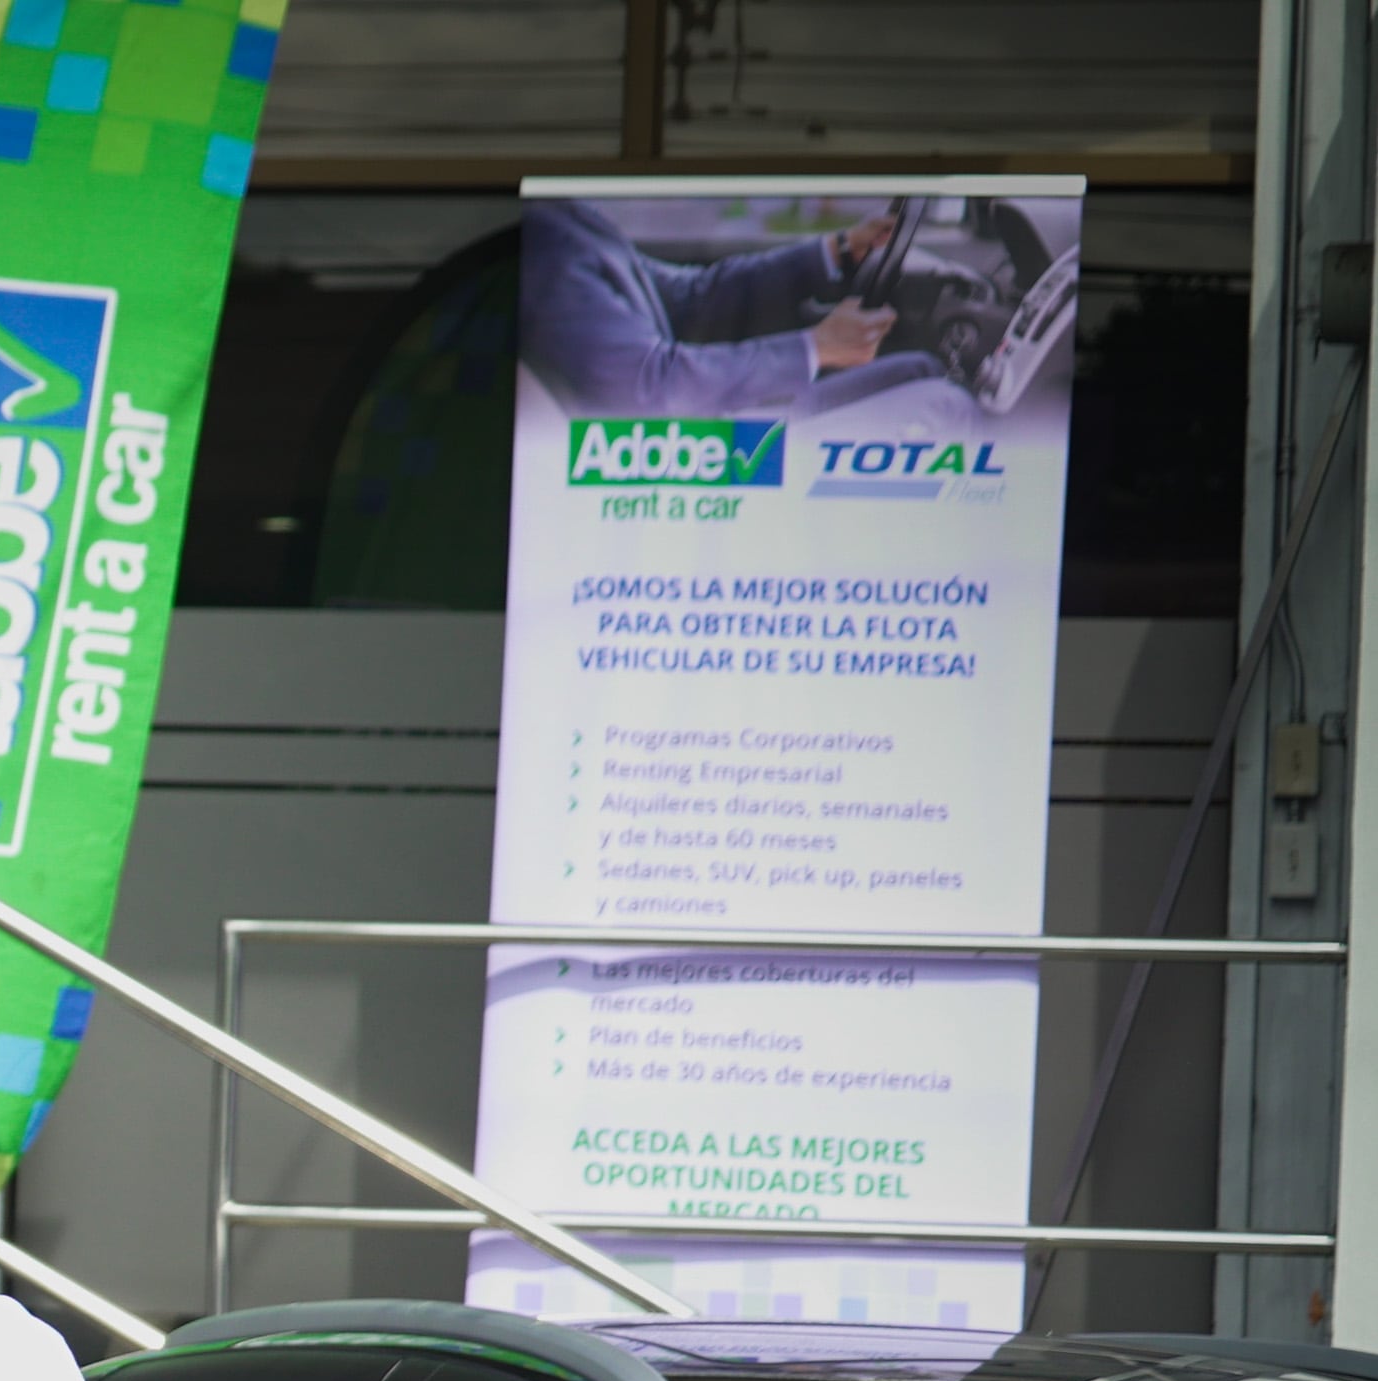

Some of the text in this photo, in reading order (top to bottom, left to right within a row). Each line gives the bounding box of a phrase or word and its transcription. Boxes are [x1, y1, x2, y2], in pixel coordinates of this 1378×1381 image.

[570, 420, 727, 482] Adobe
[818, 441, 1005, 476] TOTAL
[602, 492, 742, 521] rent a car
[50, 391, 170, 767] rent a car
[573, 574, 988, 607] ¡SOMOS LA MEJOR SOLUCIÓN
[598, 612, 957, 641] PARA OBTENER LA FLOTA
[578, 647, 976, 678] VEHICULAR DE SU EMPRESA!
[604, 724, 893, 754] Programas Corporativos
[602, 760, 843, 787] Renting Empresarial
[600, 794, 949, 821] Alquileres diarios, semanales
[598, 827, 837, 852] y de hasta 60 meses
[769, 863, 816, 887] pick
[869, 867, 963, 891] paneles
[595, 893, 727, 916] y camiones
[591, 960, 915, 987] Las mejores coberturas del
[590, 992, 693, 1014] mercado
[589, 1026, 803, 1052] Plan de beneficios
[588, 1058, 951, 1093] Más de 30 años de experiencia
[573, 1128, 924, 1166] ACCEDA A LAS MEJORES
[583, 1163, 909, 1198] OPORTUNIDADES DEL
